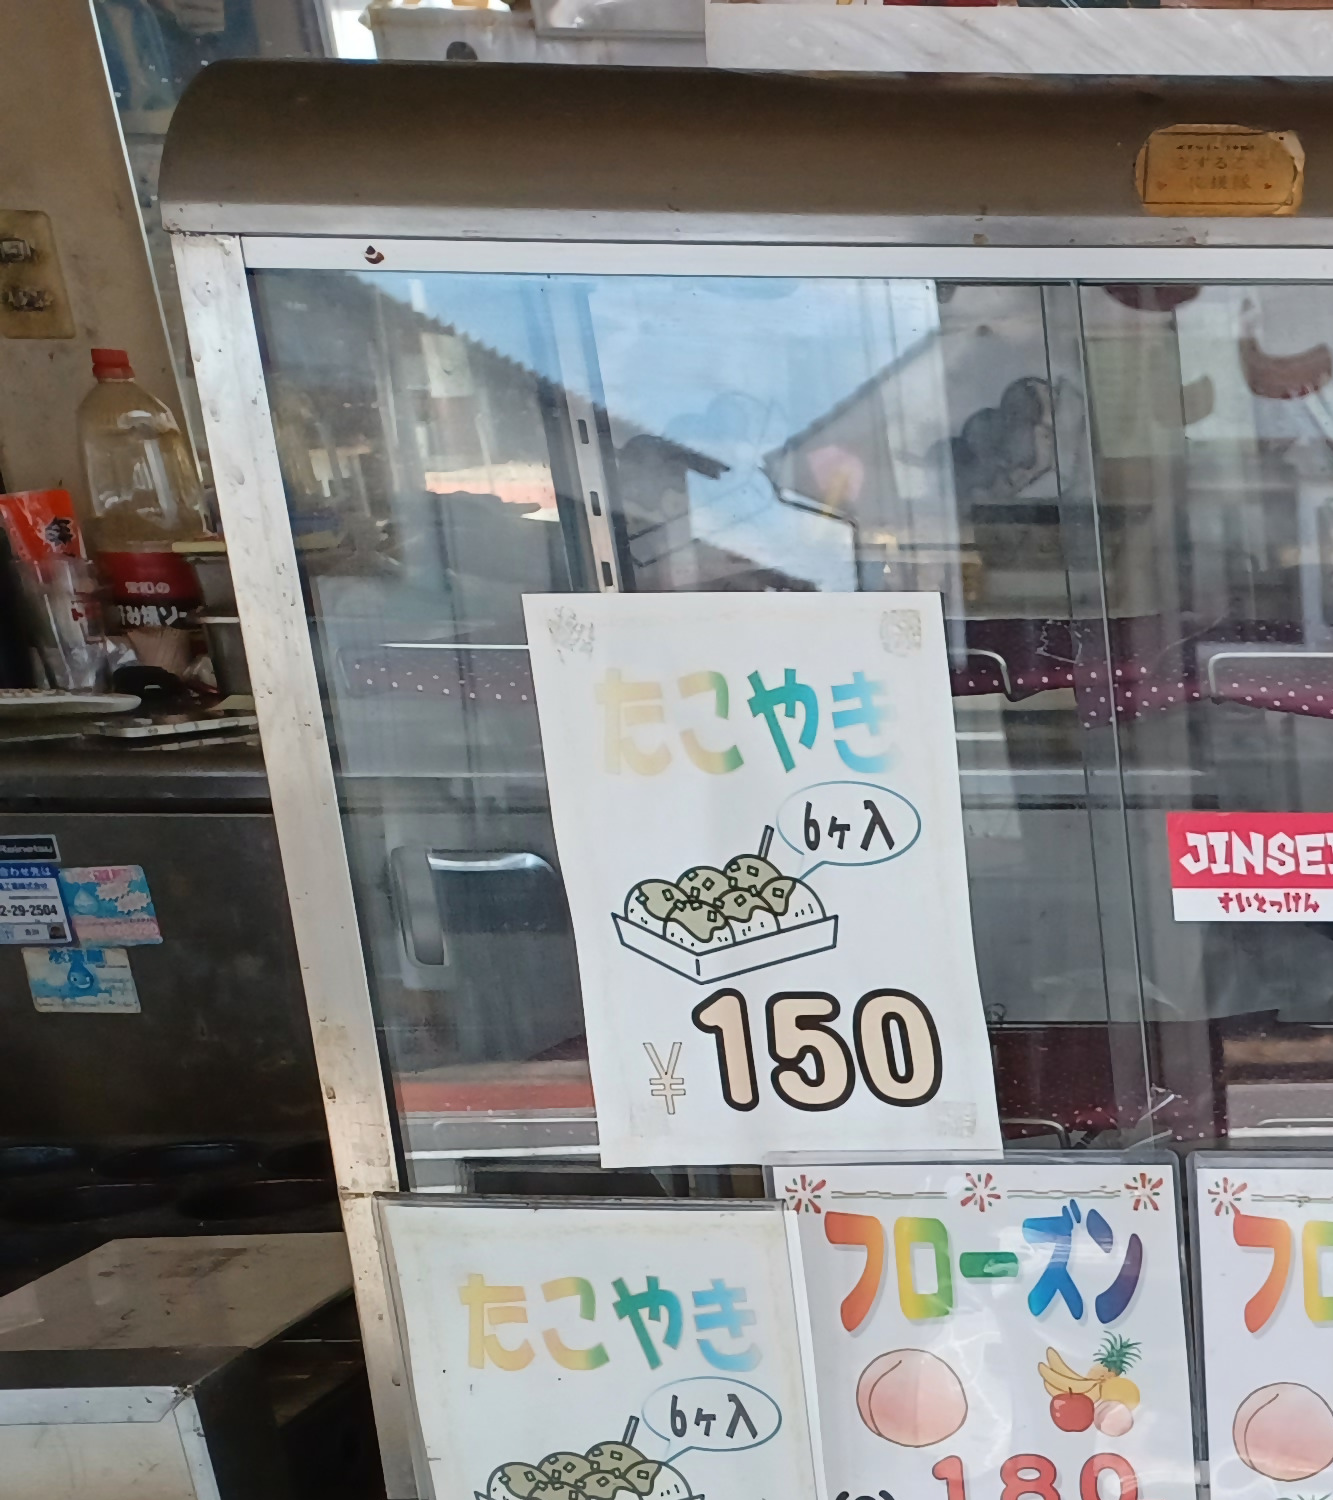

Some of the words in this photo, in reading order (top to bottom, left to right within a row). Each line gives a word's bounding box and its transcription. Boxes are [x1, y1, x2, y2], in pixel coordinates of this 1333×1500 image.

[594, 667, 900, 774] たこやき
[1217, 892, 1320, 914] すいとっけん
[823, 1199, 1143, 1333] フローズン
[458, 1273, 763, 1371] たこやき
